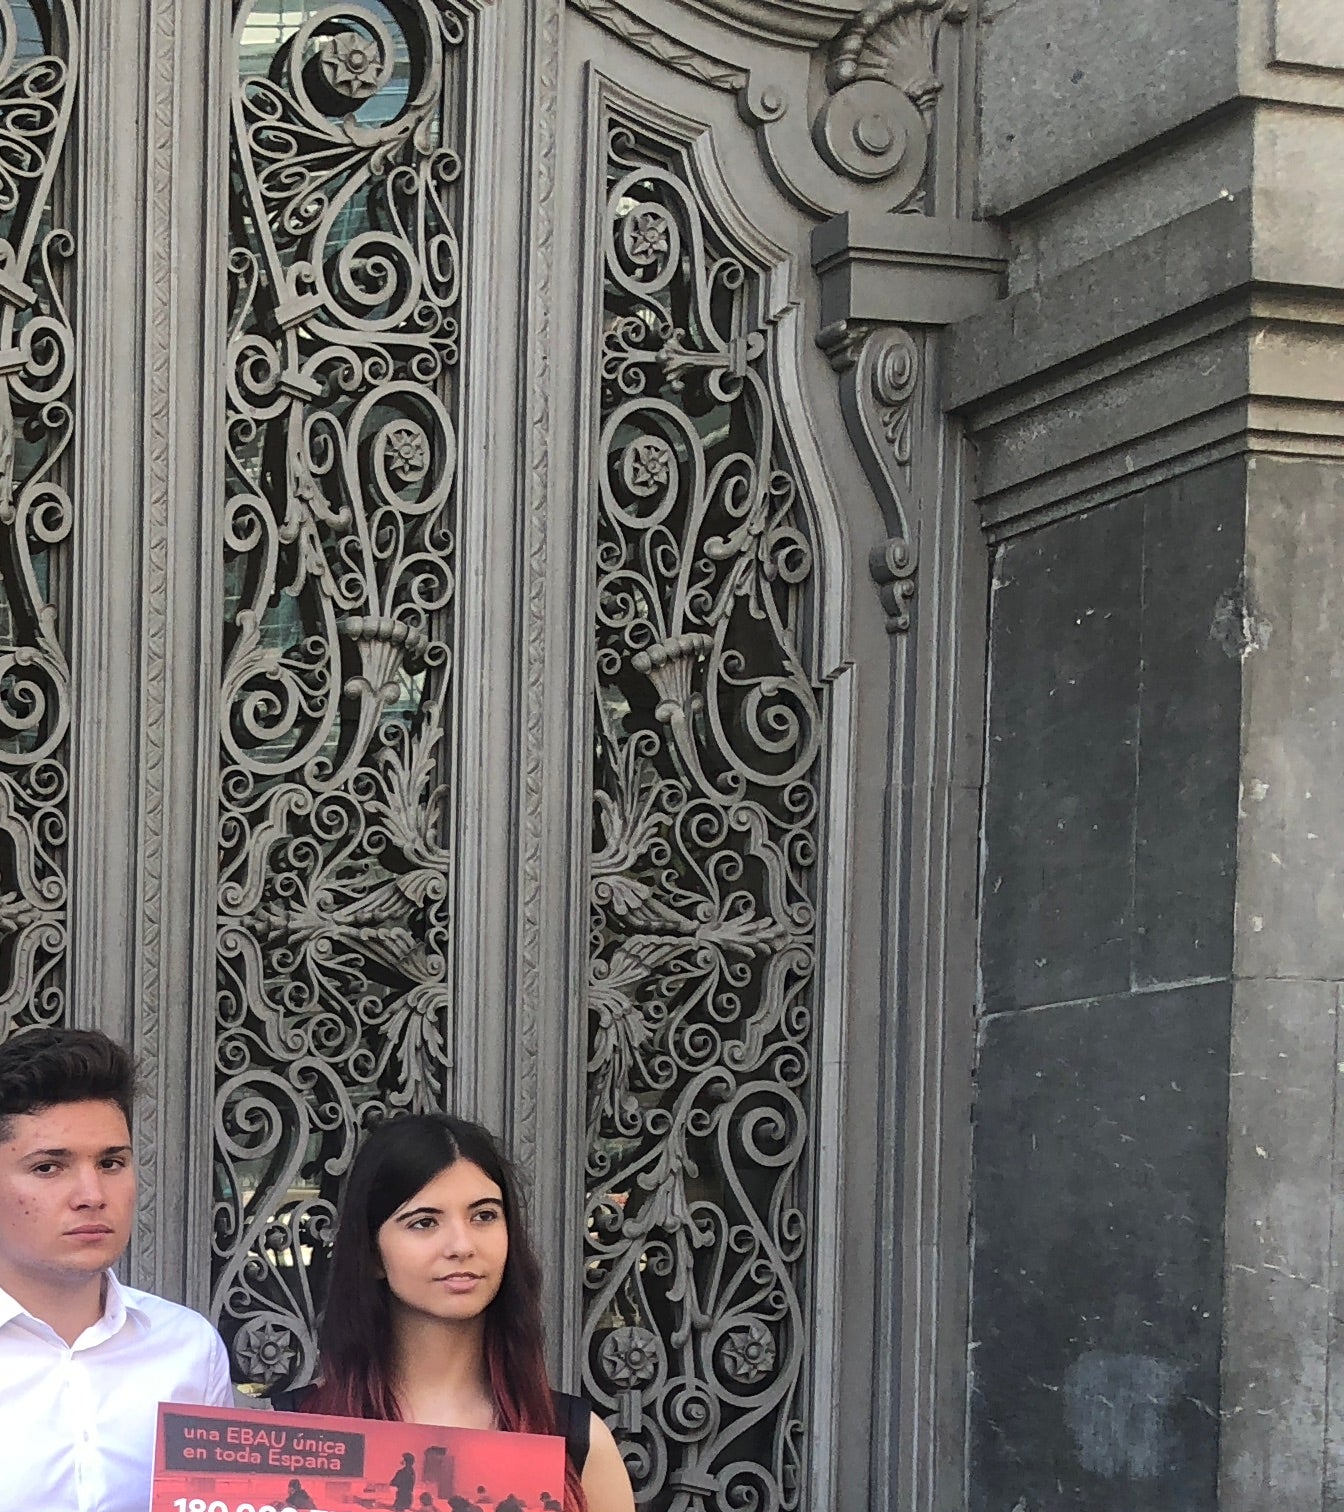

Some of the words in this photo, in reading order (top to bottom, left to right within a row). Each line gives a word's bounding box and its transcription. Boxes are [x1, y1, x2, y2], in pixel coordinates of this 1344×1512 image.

[184, 1427, 220, 1442] una
[226, 1426, 287, 1448] EBAU
[293, 1433, 346, 1455] única
[183, 1447, 207, 1459] en
[215, 1447, 261, 1464] toda
[268, 1449, 341, 1471] España
